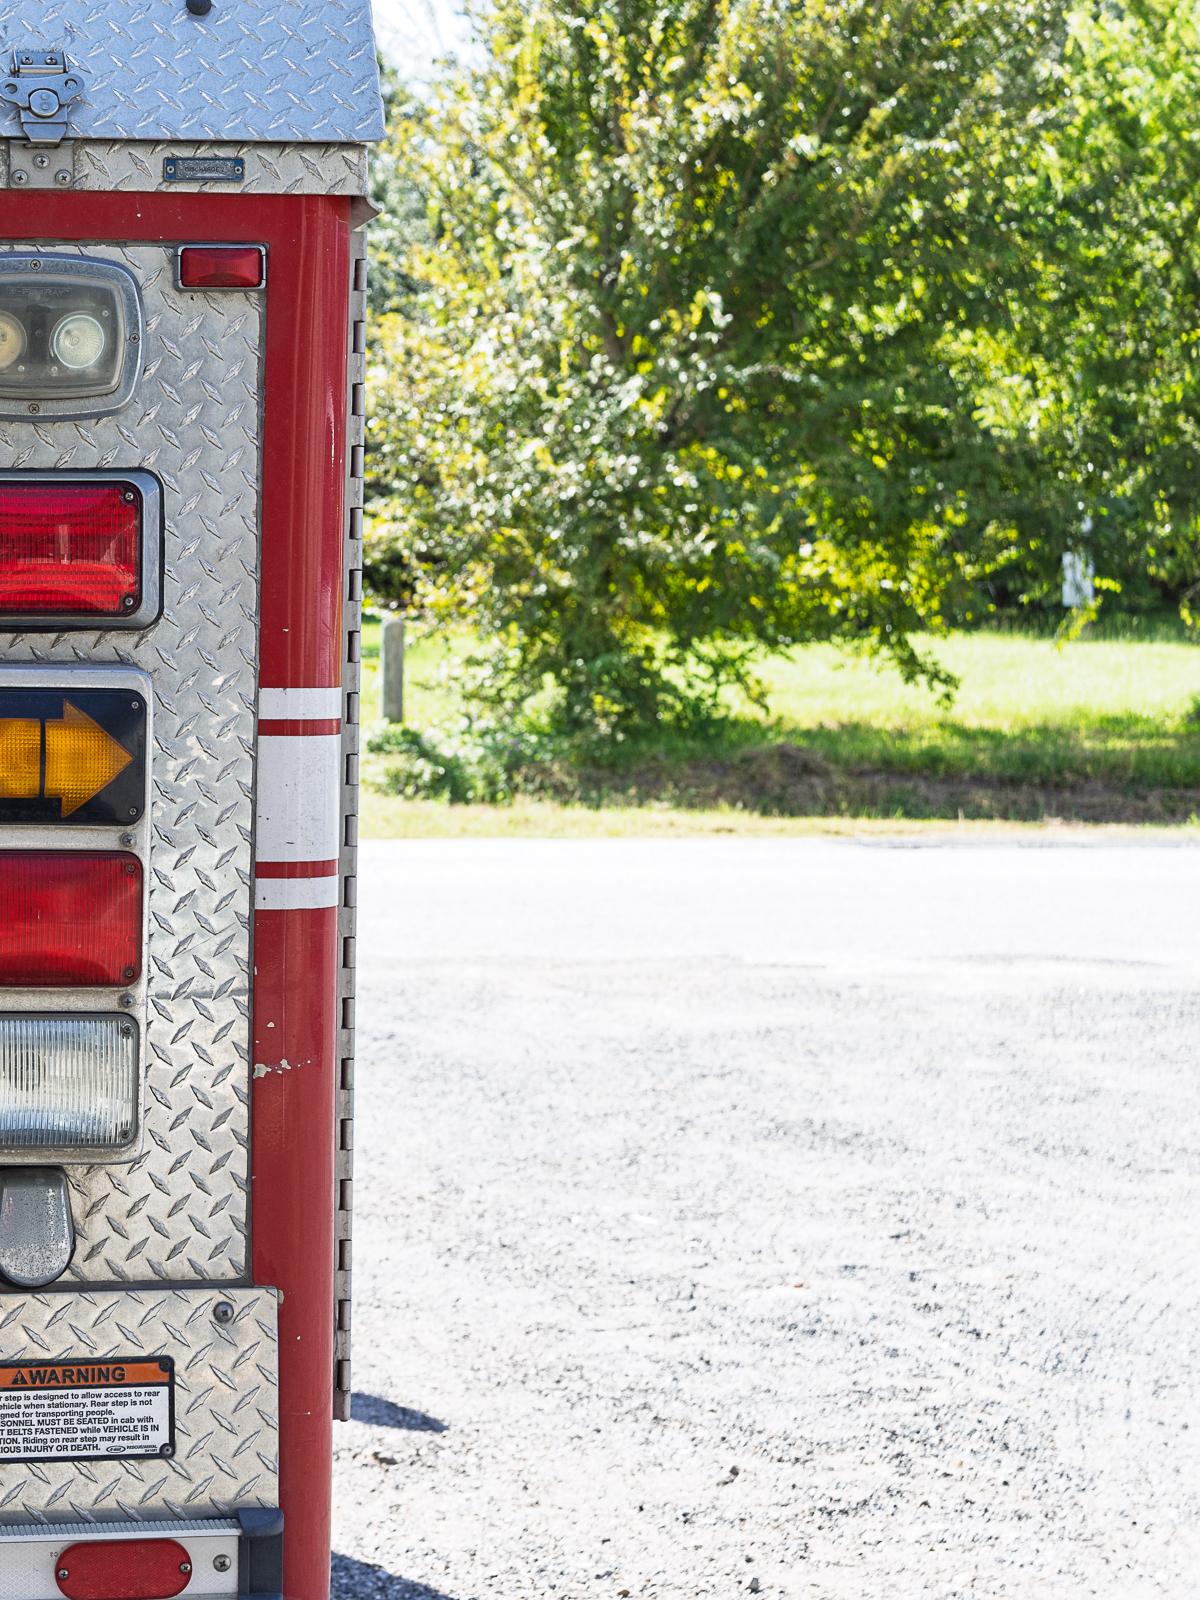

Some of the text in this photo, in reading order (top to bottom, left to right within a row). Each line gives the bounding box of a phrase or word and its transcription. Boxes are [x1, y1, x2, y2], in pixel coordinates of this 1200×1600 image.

[29, 1366, 126, 1385] WARNING
[4, 1394, 22, 1403] step
[32, 1393, 69, 1401] designed
[47, 1401, 89, 1409] stationary.
[111, 1400, 129, 1408] step
[35, 1410, 84, 1418] transporting
[86, 1409, 115, 1417] people.
[63, 1418, 75, 1426] BE
[76, 1417, 109, 1425] SEATED
[120, 1416, 135, 1424] cab
[6, 1428, 33, 1436] BELTS
[34, 1427, 78, 1435] FASTENED
[80, 1426, 101, 1434] while
[102, 1425, 139, 1433] VEHICLE
[140, 1424, 149, 1432] IS
[150, 1424, 160, 1432] IN
[22, 1437, 48, 1445] Riding
[80, 1435, 98, 1444] step
[99, 1435, 117, 1443] may
[142, 1433, 150, 1441] in
[23, 1445, 54, 1453] INJURY
[55, 1444, 68, 1452] OR
[70, 1443, 101, 1452] DEATH.
